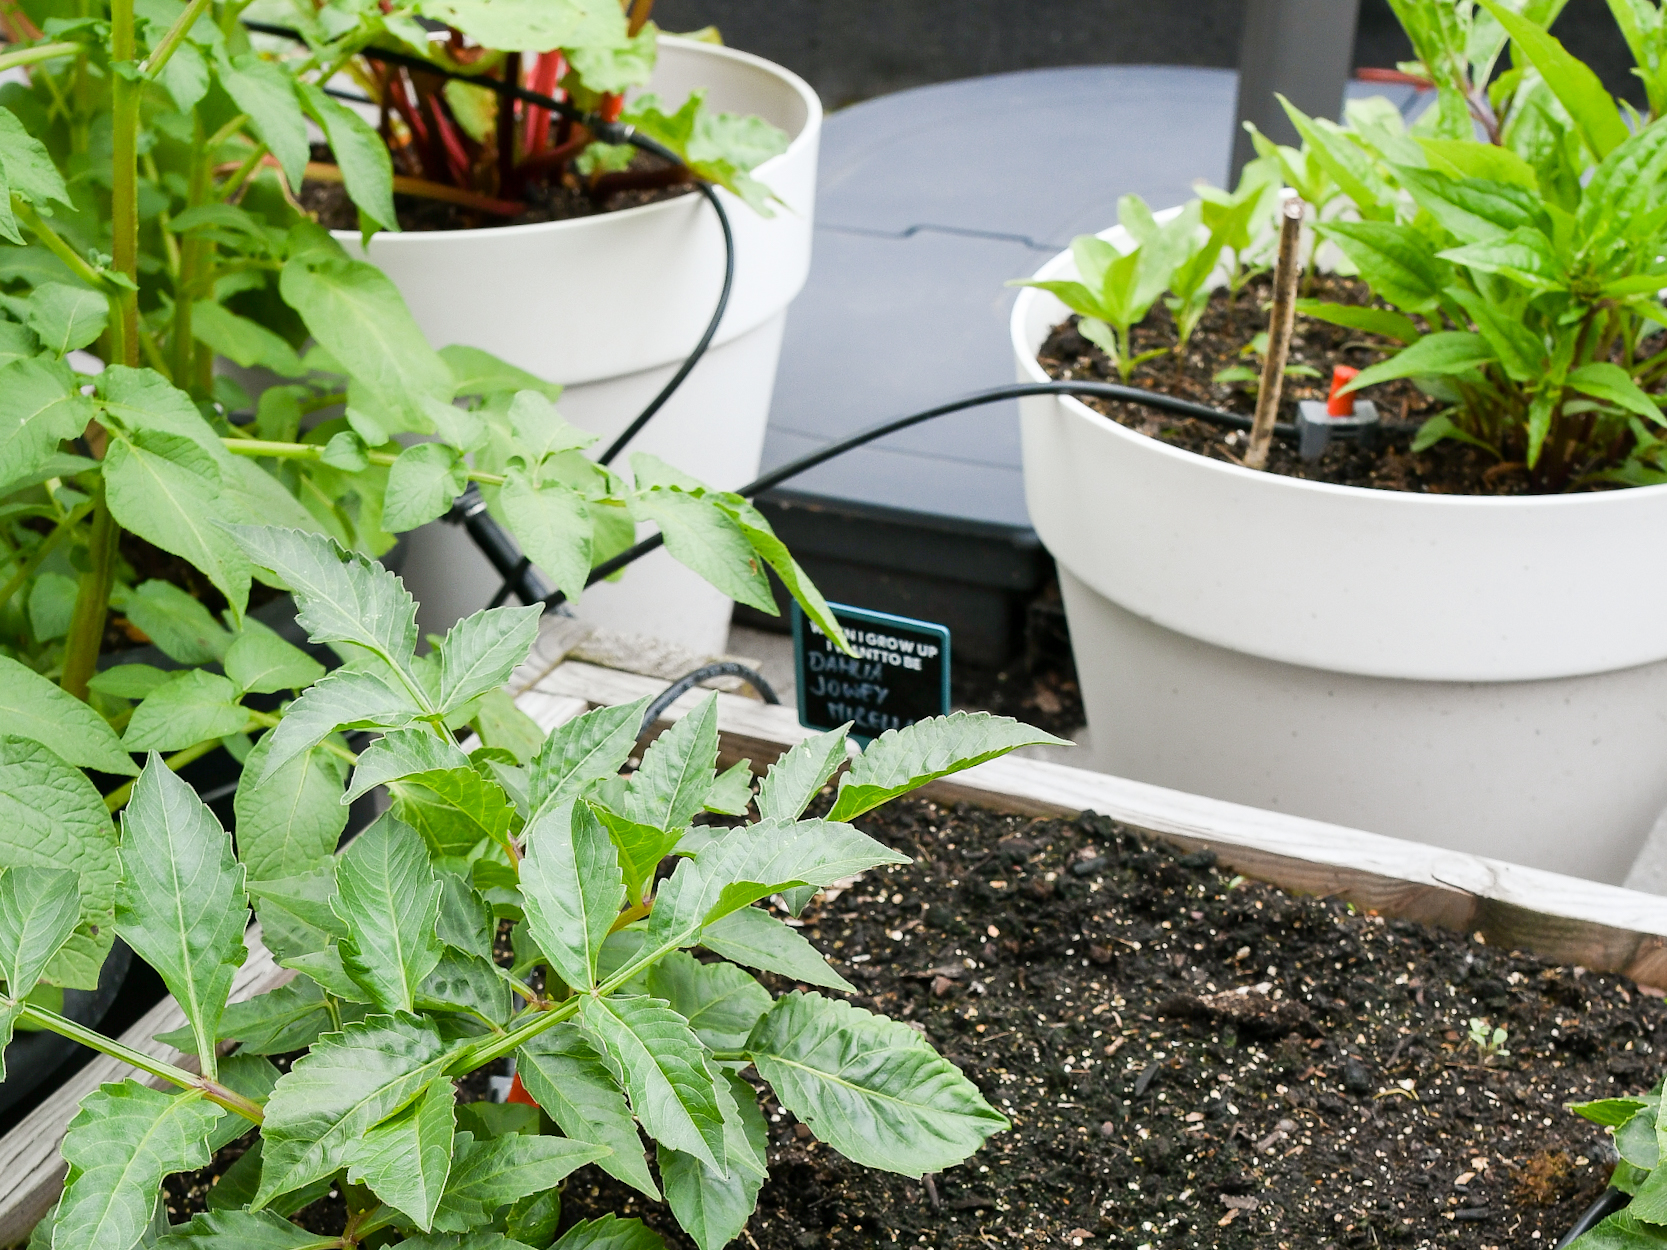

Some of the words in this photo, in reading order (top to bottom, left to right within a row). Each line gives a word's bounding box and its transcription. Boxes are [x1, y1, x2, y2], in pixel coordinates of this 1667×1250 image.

[809, 620, 857, 642] WN
[857, 630, 864, 643] I
[865, 632, 915, 654] GROW
[916, 643, 939, 659] UP
[825, 638, 832, 652] I
[880, 650, 902, 666] TO
[902, 655, 922, 671] BE
[808, 650, 883, 681] DAHLIA
